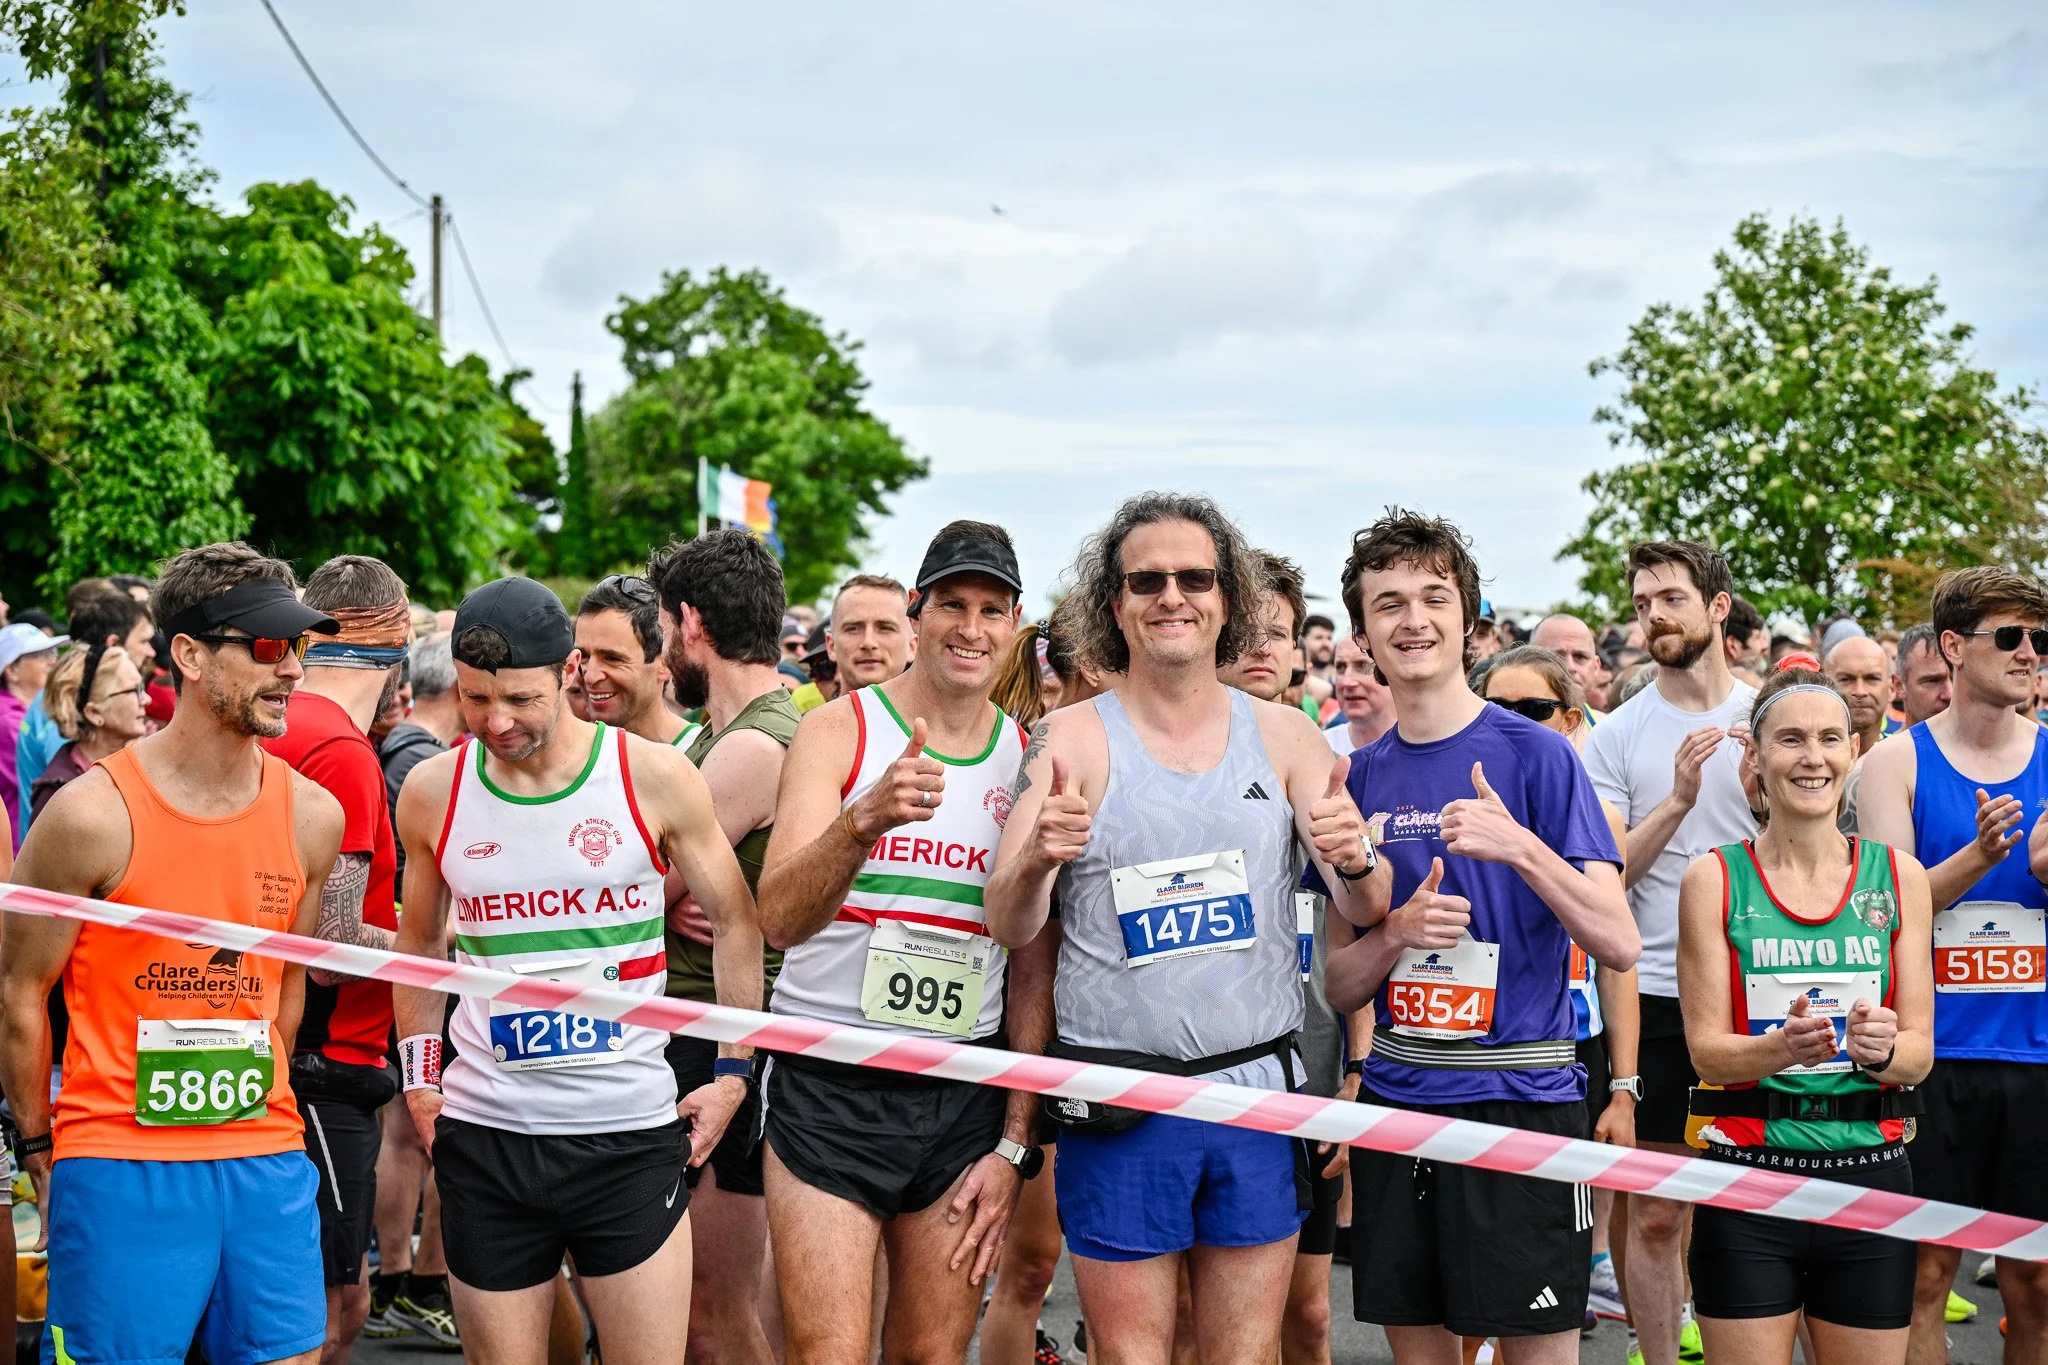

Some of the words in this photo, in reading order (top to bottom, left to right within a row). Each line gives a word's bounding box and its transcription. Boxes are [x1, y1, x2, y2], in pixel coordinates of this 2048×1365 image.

[568, 823, 583, 847] LIMERICK
[586, 818, 613, 829] ATHLETIC
[612, 830, 622, 845] CLUB
[869, 836, 990, 874] MERICK
[254, 871, 262, 879] 20
[262, 883, 273, 891] For
[1157, 885, 1177, 894] CLARE
[1177, 882, 1204, 890] BURREN
[458, 888, 586, 922] LIMERICK
[595, 884, 647, 913] A.C.
[1136, 900, 1235, 949] 1475
[904, 943, 922, 951] RUN
[922, 946, 960, 959] RESULTS
[1752, 938, 1838, 968] MAYO
[1845, 935, 1882, 966] AC
[148, 962, 199, 979] Clare
[1430, 964, 1453, 972] BURREN
[1947, 949, 2033, 981] 5158
[135, 975, 236, 992] Crusaders
[158, 992, 186, 1000] Helping
[888, 972, 964, 1020] 995
[1393, 985, 1481, 1027] 5354
[196, 1037, 238, 1046] RESULTS
[509, 1013, 597, 1055] 1218
[148, 1068, 263, 1112] 5866
[1058, 1101, 1078, 1110] NORTH
[1063, 1109, 1080, 1117] FACE
[1757, 1154, 1832, 1169] ARMOUR
